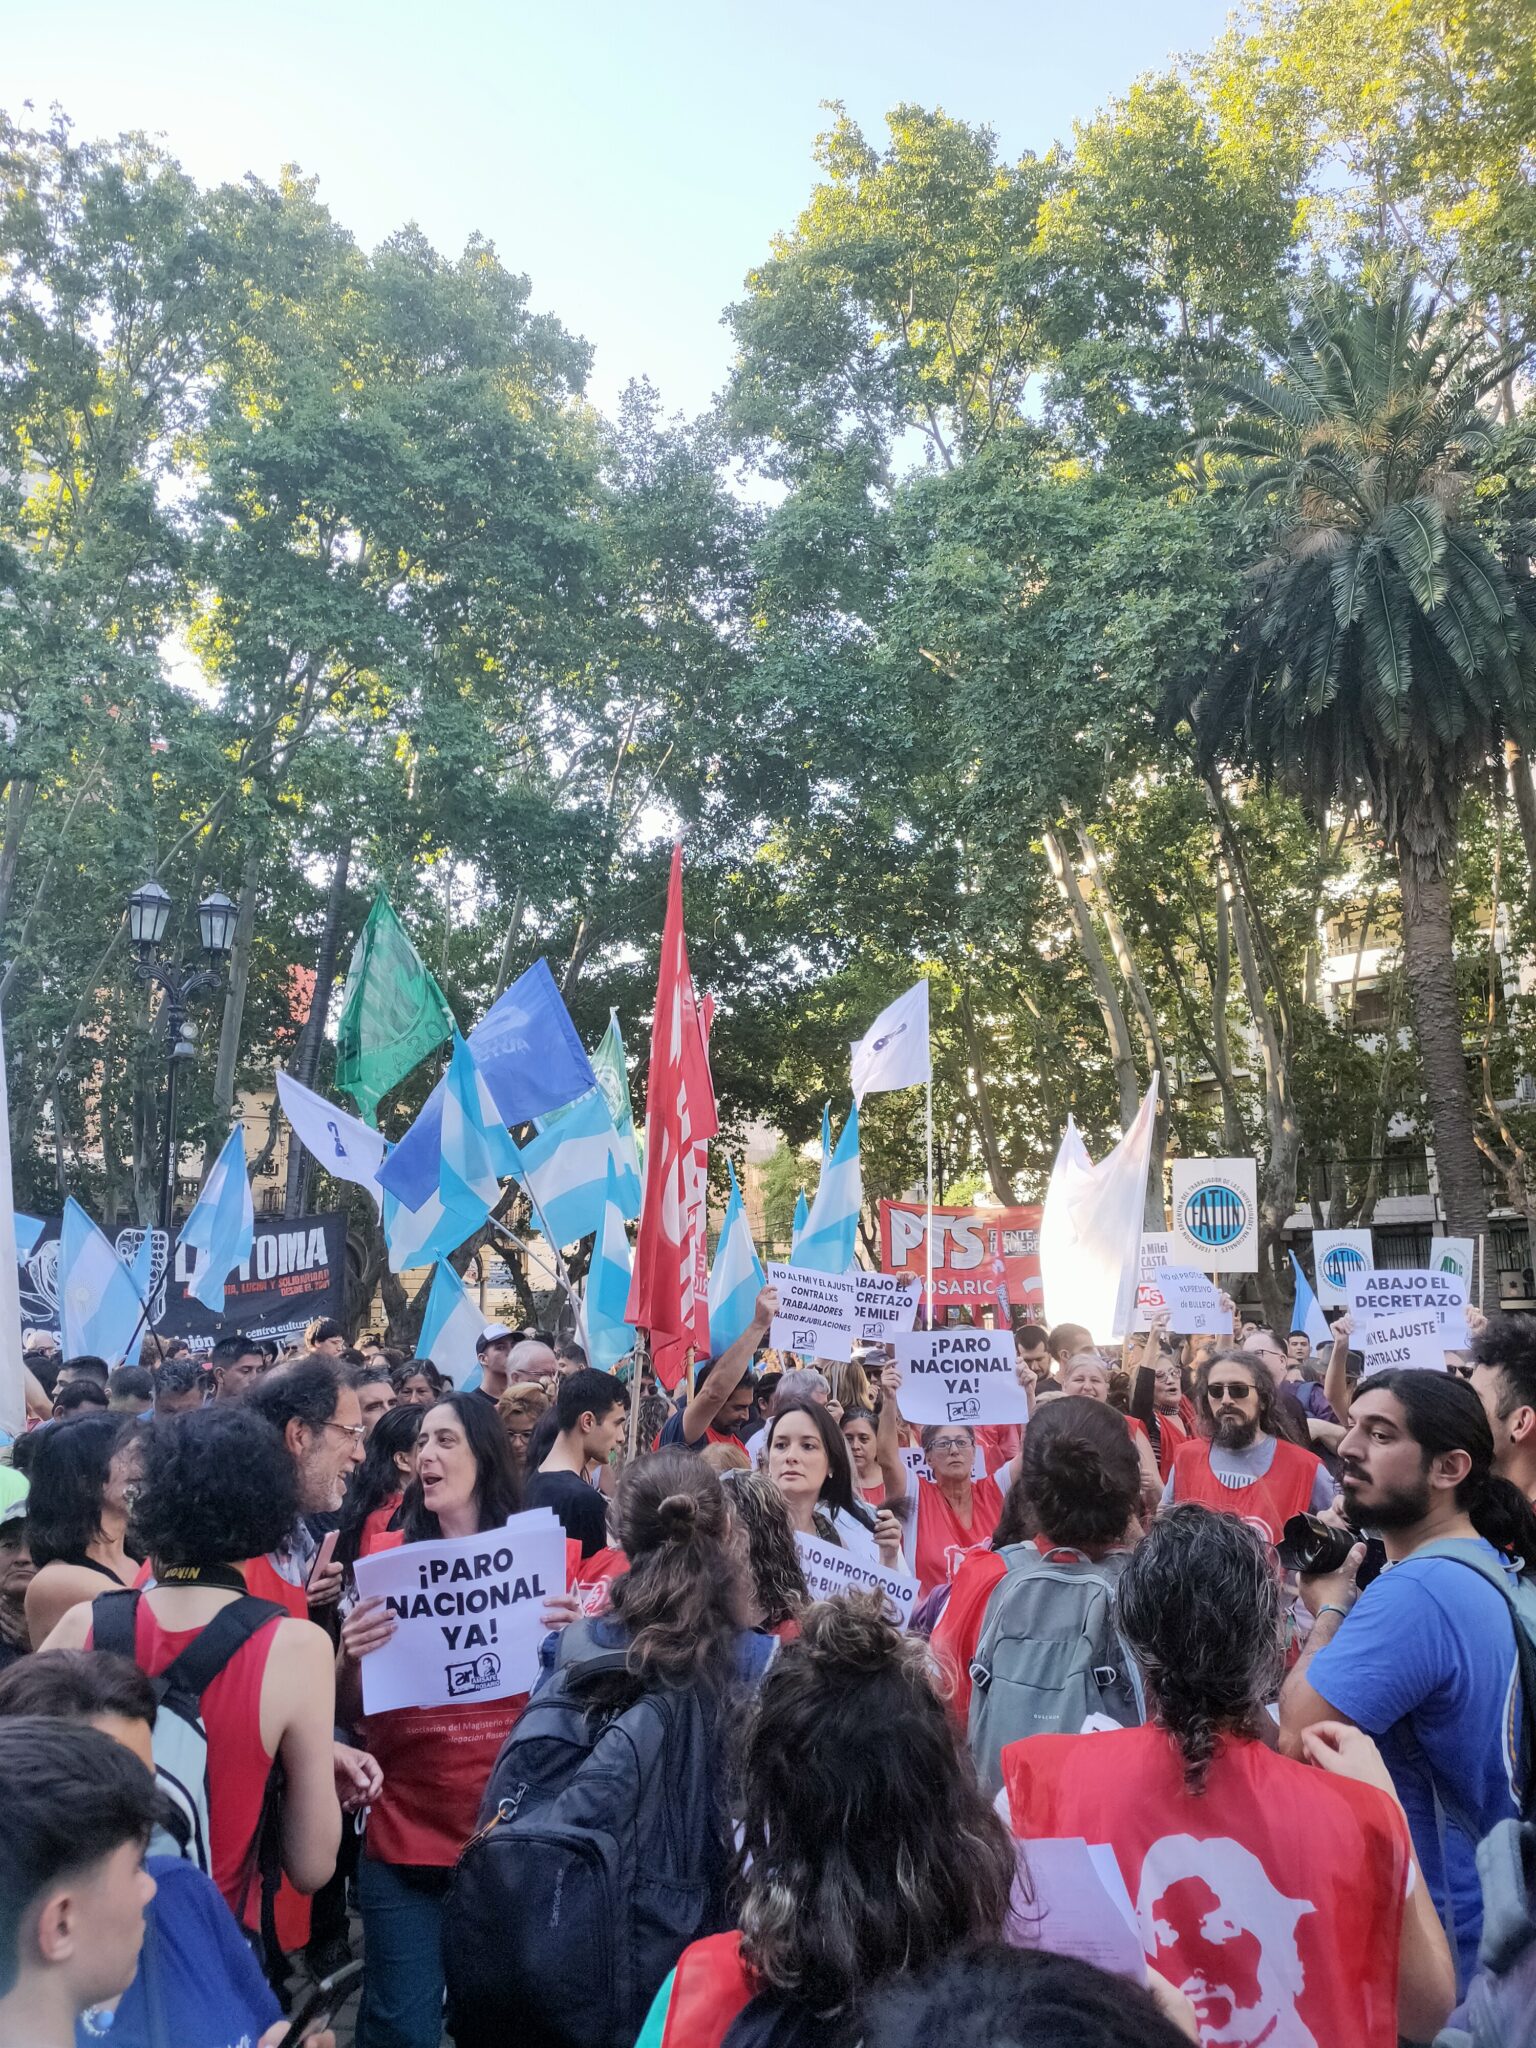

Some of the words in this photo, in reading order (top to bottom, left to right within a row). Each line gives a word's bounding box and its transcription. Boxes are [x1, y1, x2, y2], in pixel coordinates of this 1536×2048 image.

[1192, 1189, 1240, 1241] FATUN
[889, 1208, 985, 1270] PTS
[989, 1229, 1033, 1241] FENTE
[989, 1241, 1040, 1253] IQUIERD
[1147, 1242, 1168, 1255] Milei
[1141, 1255, 1168, 1267] CASTA
[268, 1281, 276, 1290] Y
[773, 1270, 786, 1279] NO
[788, 1272, 798, 1281] AL
[798, 1274, 812, 1285] FMI
[812, 1276, 818, 1284] Y
[819, 1279, 827, 1288] EL
[827, 1281, 855, 1293] AJUSTE
[920, 1279, 996, 1295] OSARIO
[1179, 1285, 1212, 1293] REPRESIVO
[1365, 1276, 1428, 1290] ABAJO
[1431, 1277, 1450, 1289] EL
[791, 1286, 824, 1299] CONTRA
[825, 1293, 839, 1303] LXS
[856, 1291, 913, 1307] CRETAZO
[1355, 1294, 1462, 1308] DECRETAZO
[782, 1297, 843, 1317] TRABAJADORES
[868, 1307, 899, 1321] MILEI
[246, 1327, 276, 1338] centro
[277, 1316, 313, 1332] cultural
[773, 1311, 799, 1322] ALARIO
[799, 1315, 851, 1332] #JUBILACIONES
[1377, 1330, 1389, 1343] EL
[1389, 1321, 1436, 1341] AJUSTE
[932, 1337, 991, 1357] ¡PARO
[1365, 1349, 1392, 1366] CONTRA
[1391, 1347, 1411, 1362] LXS
[910, 1357, 1012, 1374] NACIONAL
[944, 1378, 980, 1394] YA!
[164, 1566, 200, 1580] Nikon
[418, 1547, 514, 1590] ¡PARO
[794, 1544, 822, 1564] AJO
[823, 1557, 835, 1571] el
[836, 1560, 913, 1601] PROTOCOLO
[804, 1570, 818, 1587] de
[386, 1573, 547, 1619] NACIONAL
[440, 1618, 498, 1650] YA!
[406, 1725, 446, 1734] Asociación
[448, 1723, 460, 1732] del
[462, 1719, 503, 1731] Magisterio
